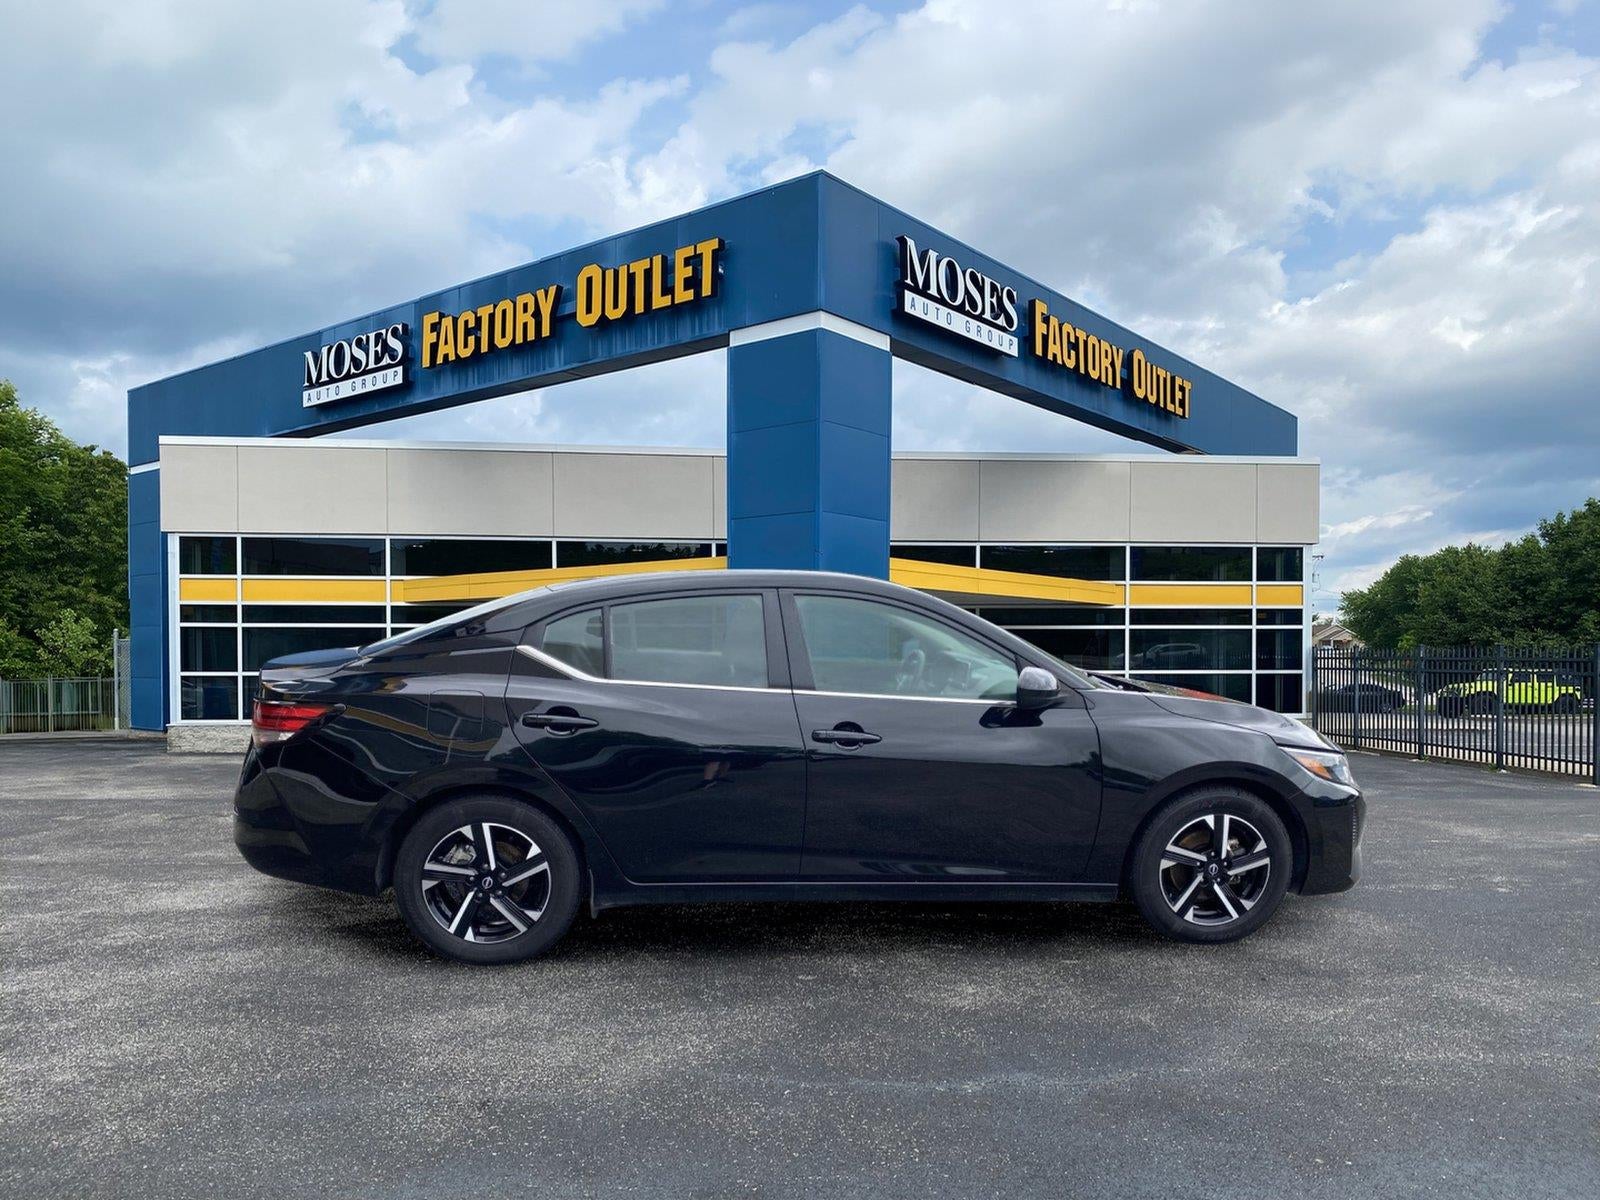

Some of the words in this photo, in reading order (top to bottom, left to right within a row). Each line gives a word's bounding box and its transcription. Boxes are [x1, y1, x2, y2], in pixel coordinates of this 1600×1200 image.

[421, 284, 559, 368] FACTORY
[576, 237, 721, 328] OUTLET
[903, 235, 1019, 332] MOSES
[909, 296, 953, 326] AUTO
[964, 319, 1016, 351] GROUP
[303, 323, 405, 387] MOSES
[307, 384, 341, 403] AUTO
[351, 369, 401, 391] GROUP
[1035, 298, 1124, 389] FACTORY
[1133, 348, 1192, 419] OUTLET
